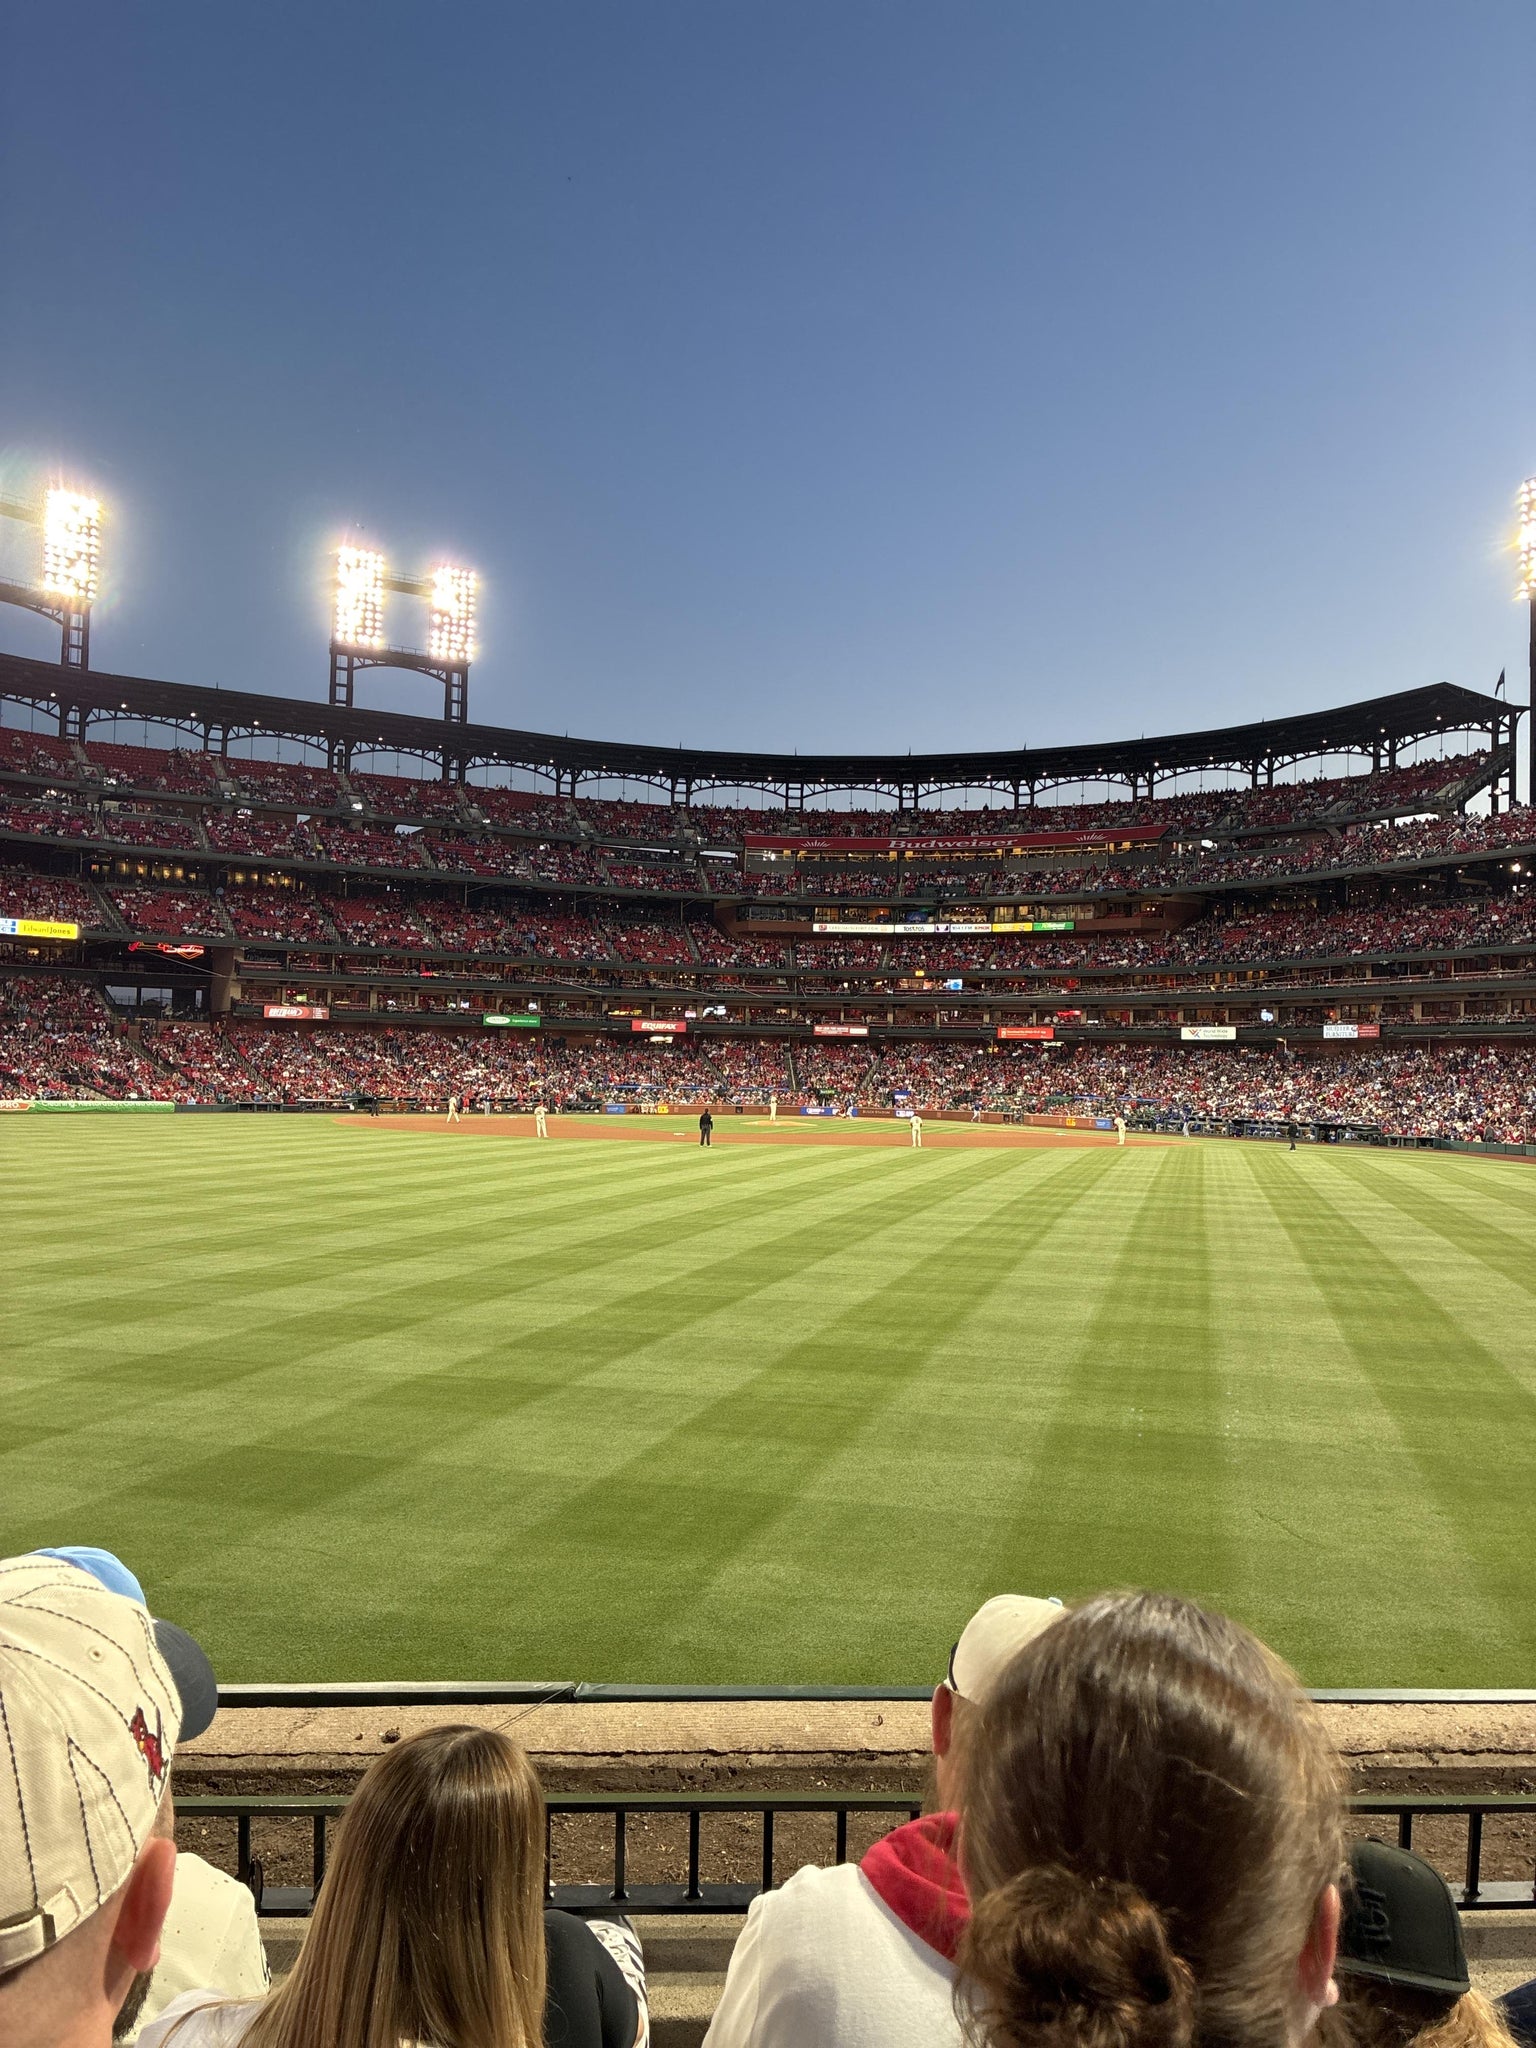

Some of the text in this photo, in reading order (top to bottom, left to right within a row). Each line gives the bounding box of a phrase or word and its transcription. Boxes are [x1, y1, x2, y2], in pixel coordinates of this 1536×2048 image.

[888, 838, 1018, 850] Budweiser
[49, 926, 71, 935] Jones
[641, 1022, 677, 1031] EQUIFAX
